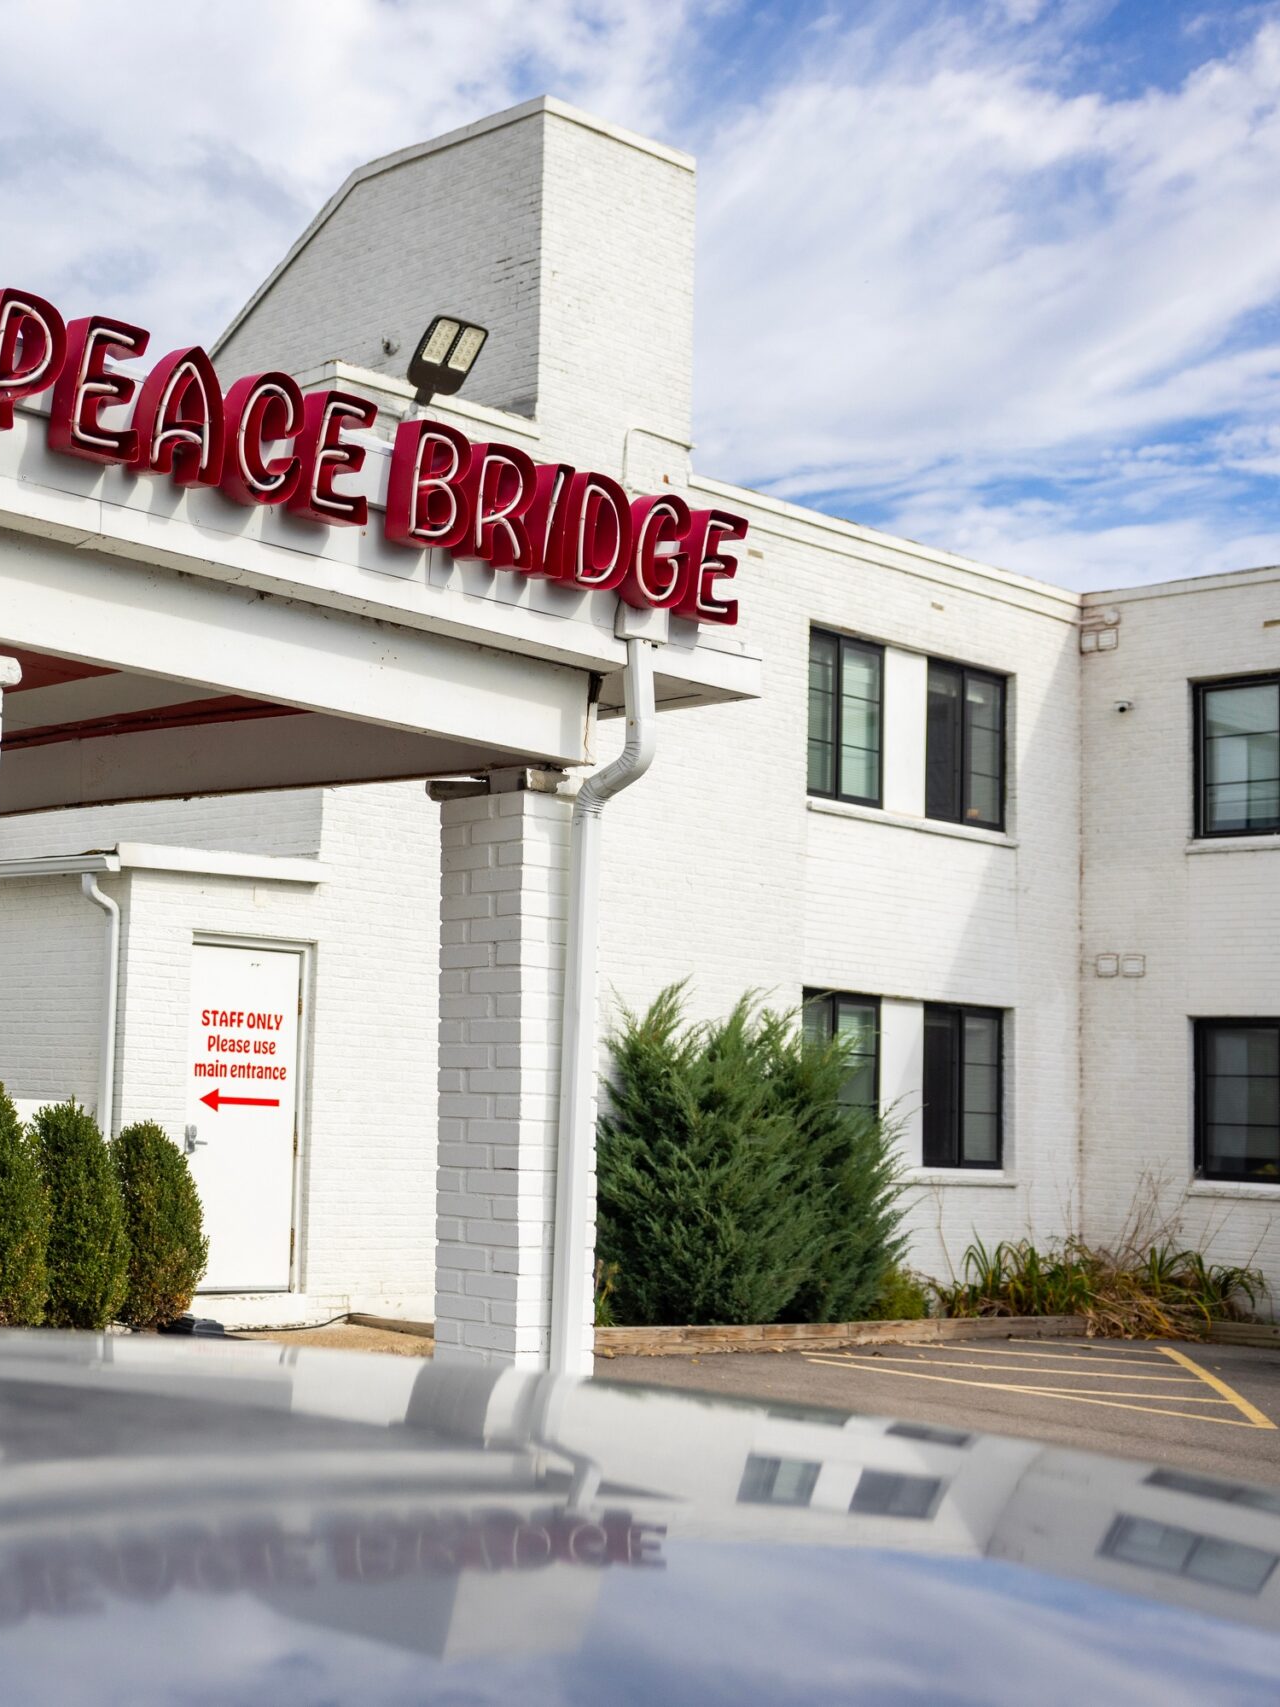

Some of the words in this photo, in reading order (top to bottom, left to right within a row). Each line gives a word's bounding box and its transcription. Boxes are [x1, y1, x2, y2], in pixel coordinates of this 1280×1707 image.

[385, 419, 749, 625] BRIDGE
[202, 1009, 244, 1028] STAFF
[246, 1012, 283, 1030] ONLY
[208, 1034, 250, 1053] Please
[254, 1041, 276, 1055] use
[194, 1059, 227, 1077] main
[230, 1062, 287, 1080] entrance
